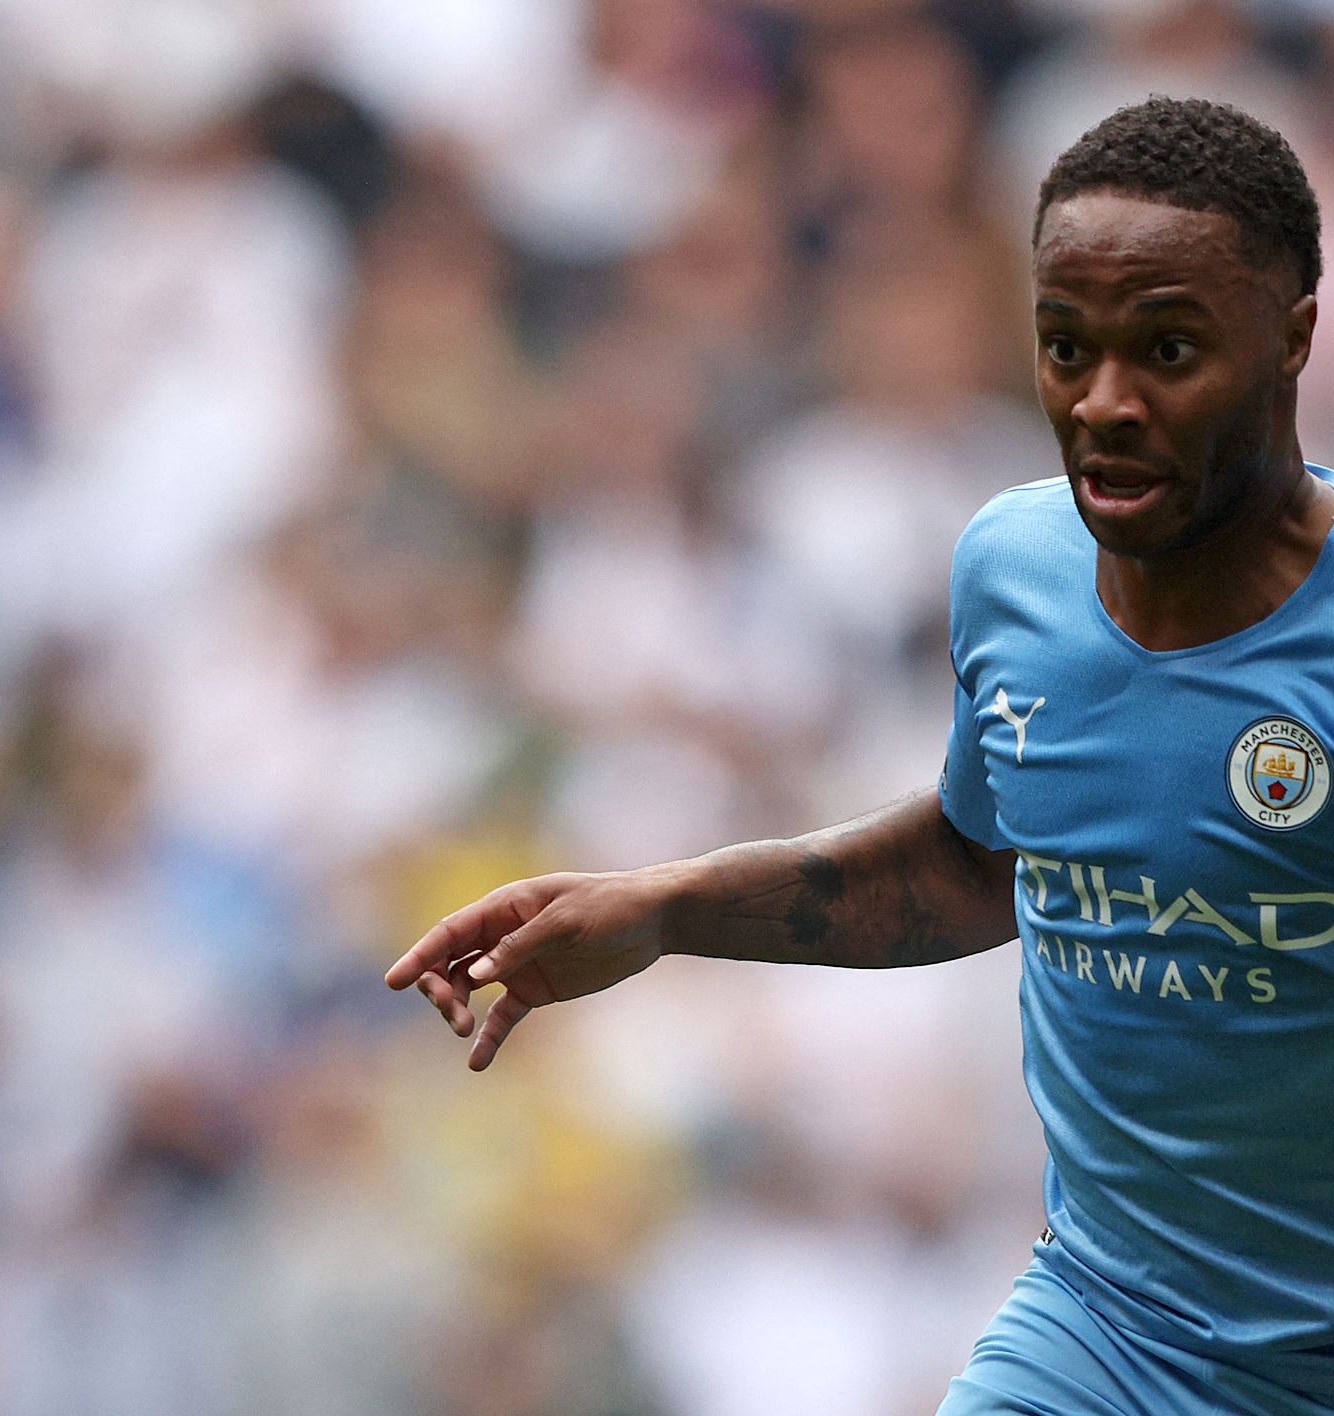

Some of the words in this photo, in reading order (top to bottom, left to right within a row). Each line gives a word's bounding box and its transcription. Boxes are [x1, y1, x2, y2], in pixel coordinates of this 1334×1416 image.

[1240, 723, 1325, 767] MANCHESTER
[1258, 810, 1292, 825] CITY
[1036, 930, 1278, 1004] AIRWAYS
